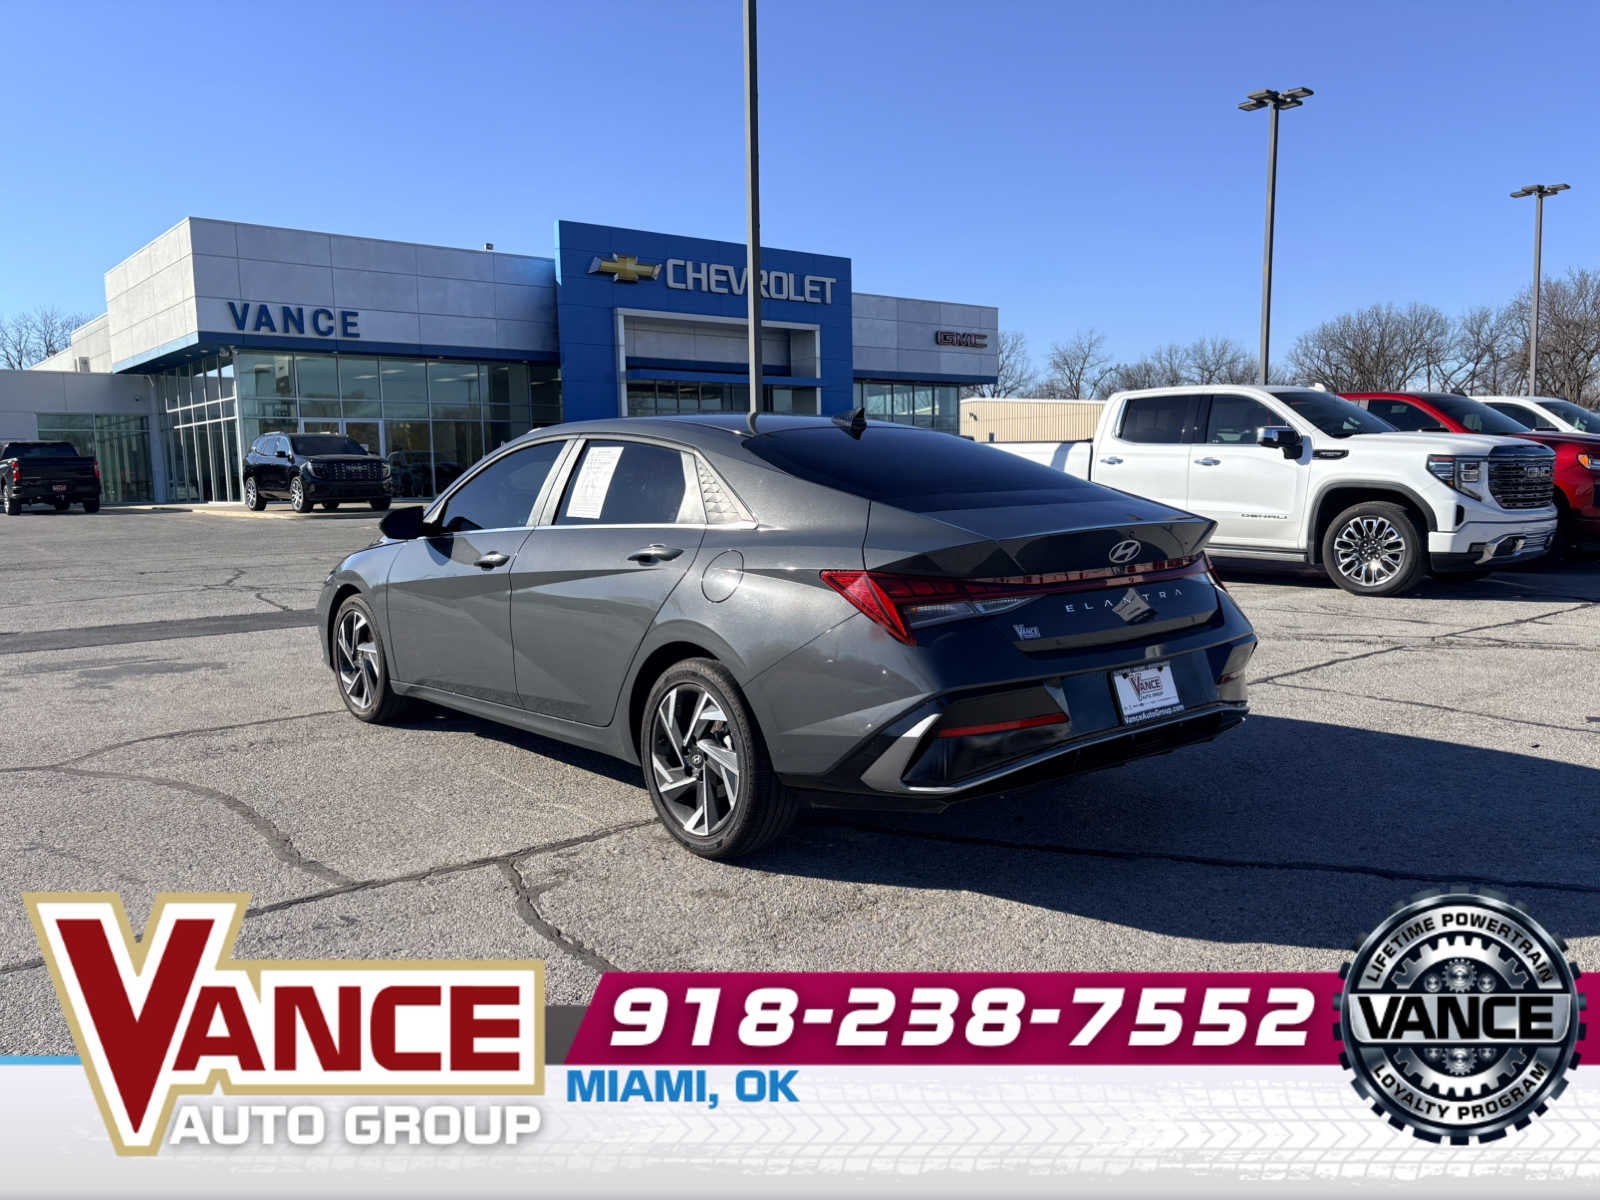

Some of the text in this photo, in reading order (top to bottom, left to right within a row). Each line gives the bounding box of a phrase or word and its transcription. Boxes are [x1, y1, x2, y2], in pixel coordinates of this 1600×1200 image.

[227, 301, 360, 338] VANCE
[936, 330, 987, 348] GMC
[1065, 589, 1183, 613] ELANTRA
[1129, 672, 1162, 701] VANCE
